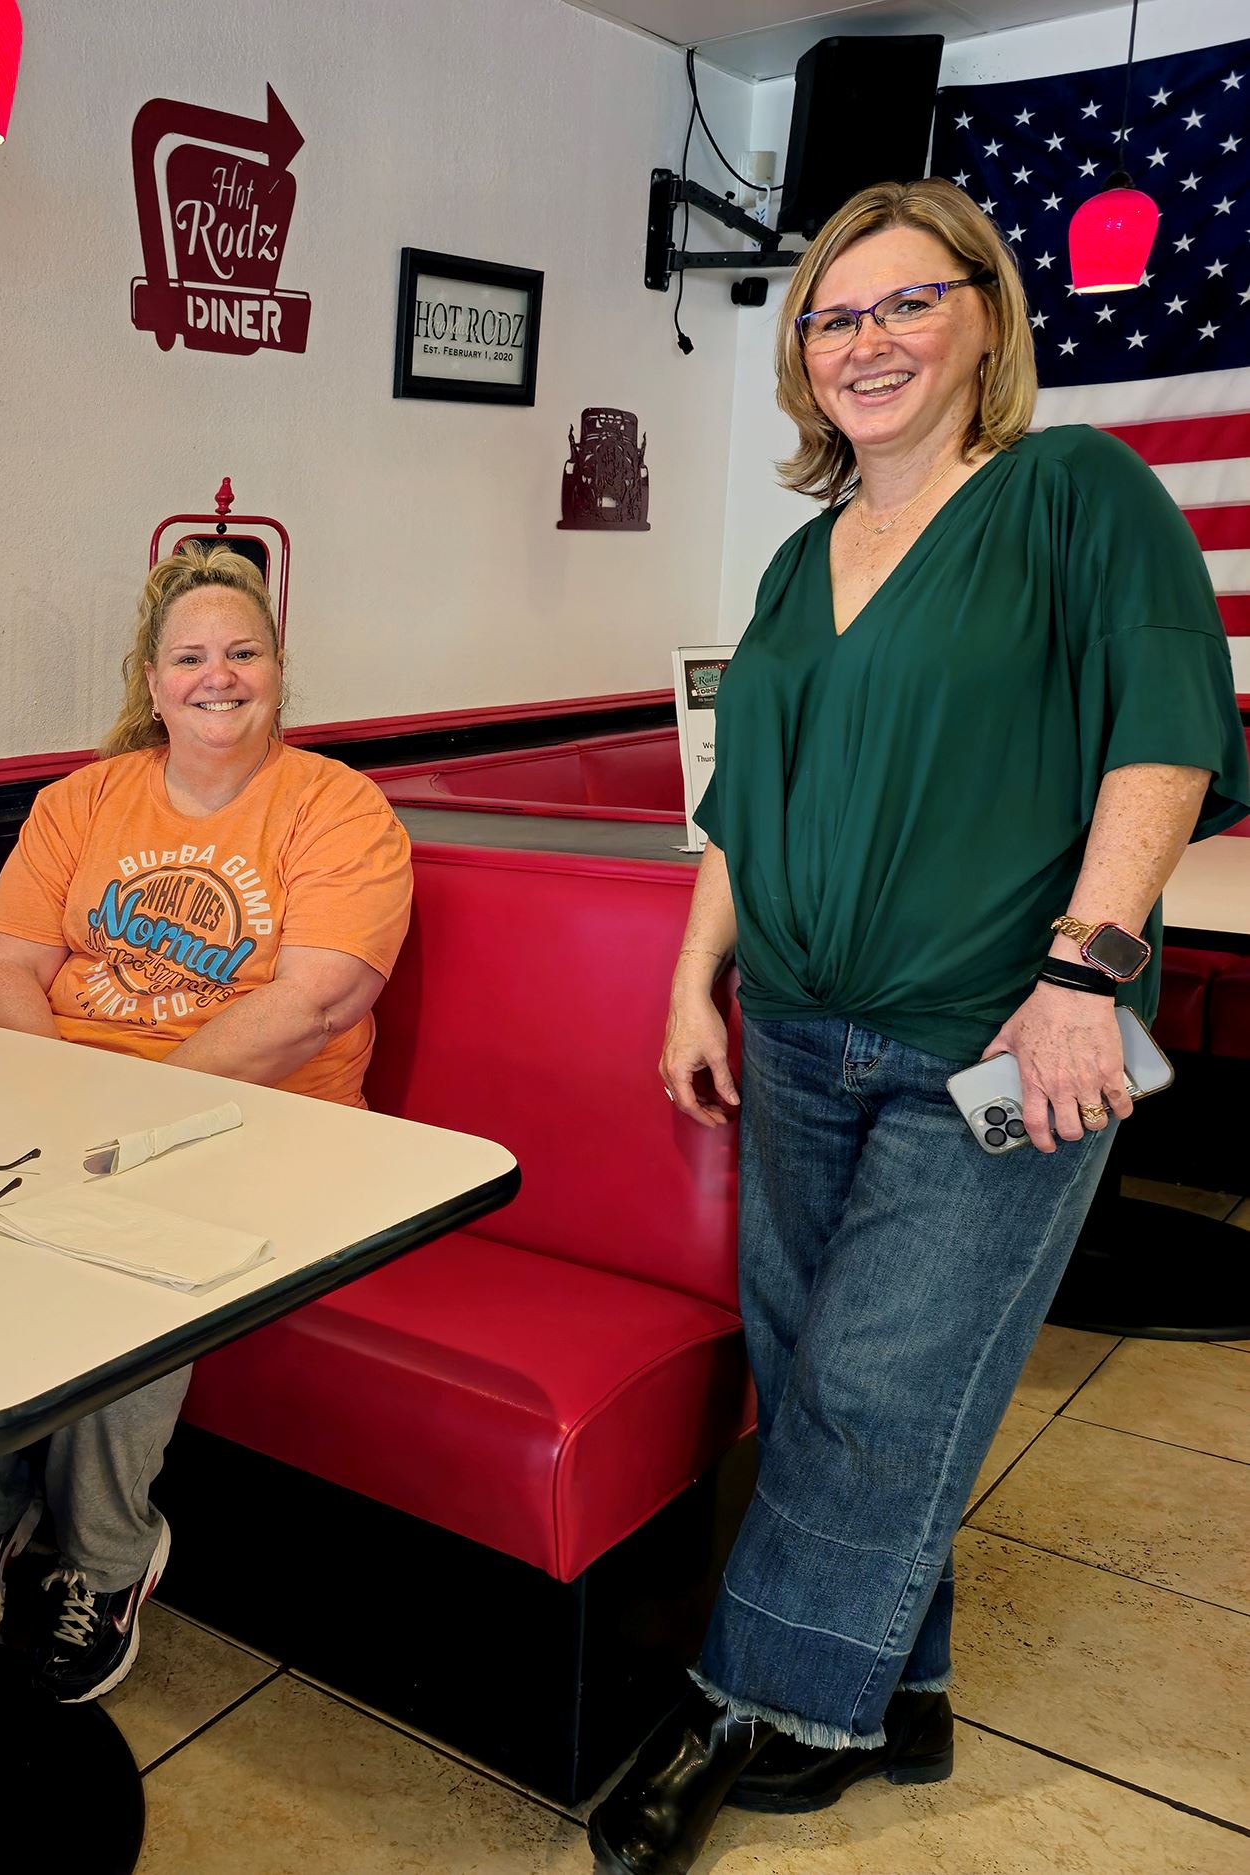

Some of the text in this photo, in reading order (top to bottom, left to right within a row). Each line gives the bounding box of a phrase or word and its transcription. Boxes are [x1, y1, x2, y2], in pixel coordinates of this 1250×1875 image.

[212, 161, 254, 210] Hot
[175, 199, 278, 280] Rodz
[187, 295, 282, 343] DINER
[414, 300, 462, 341] HOT
[466, 307, 525, 348] RODZ
[493, 352, 513, 361] 2020
[118, 844, 273, 936] BUBBA GUMP
[141, 875, 195, 918] WHAT
[88, 879, 257, 985] Normal
[75, 991, 96, 1017] LAS
[152, 991, 195, 1022] CO.
